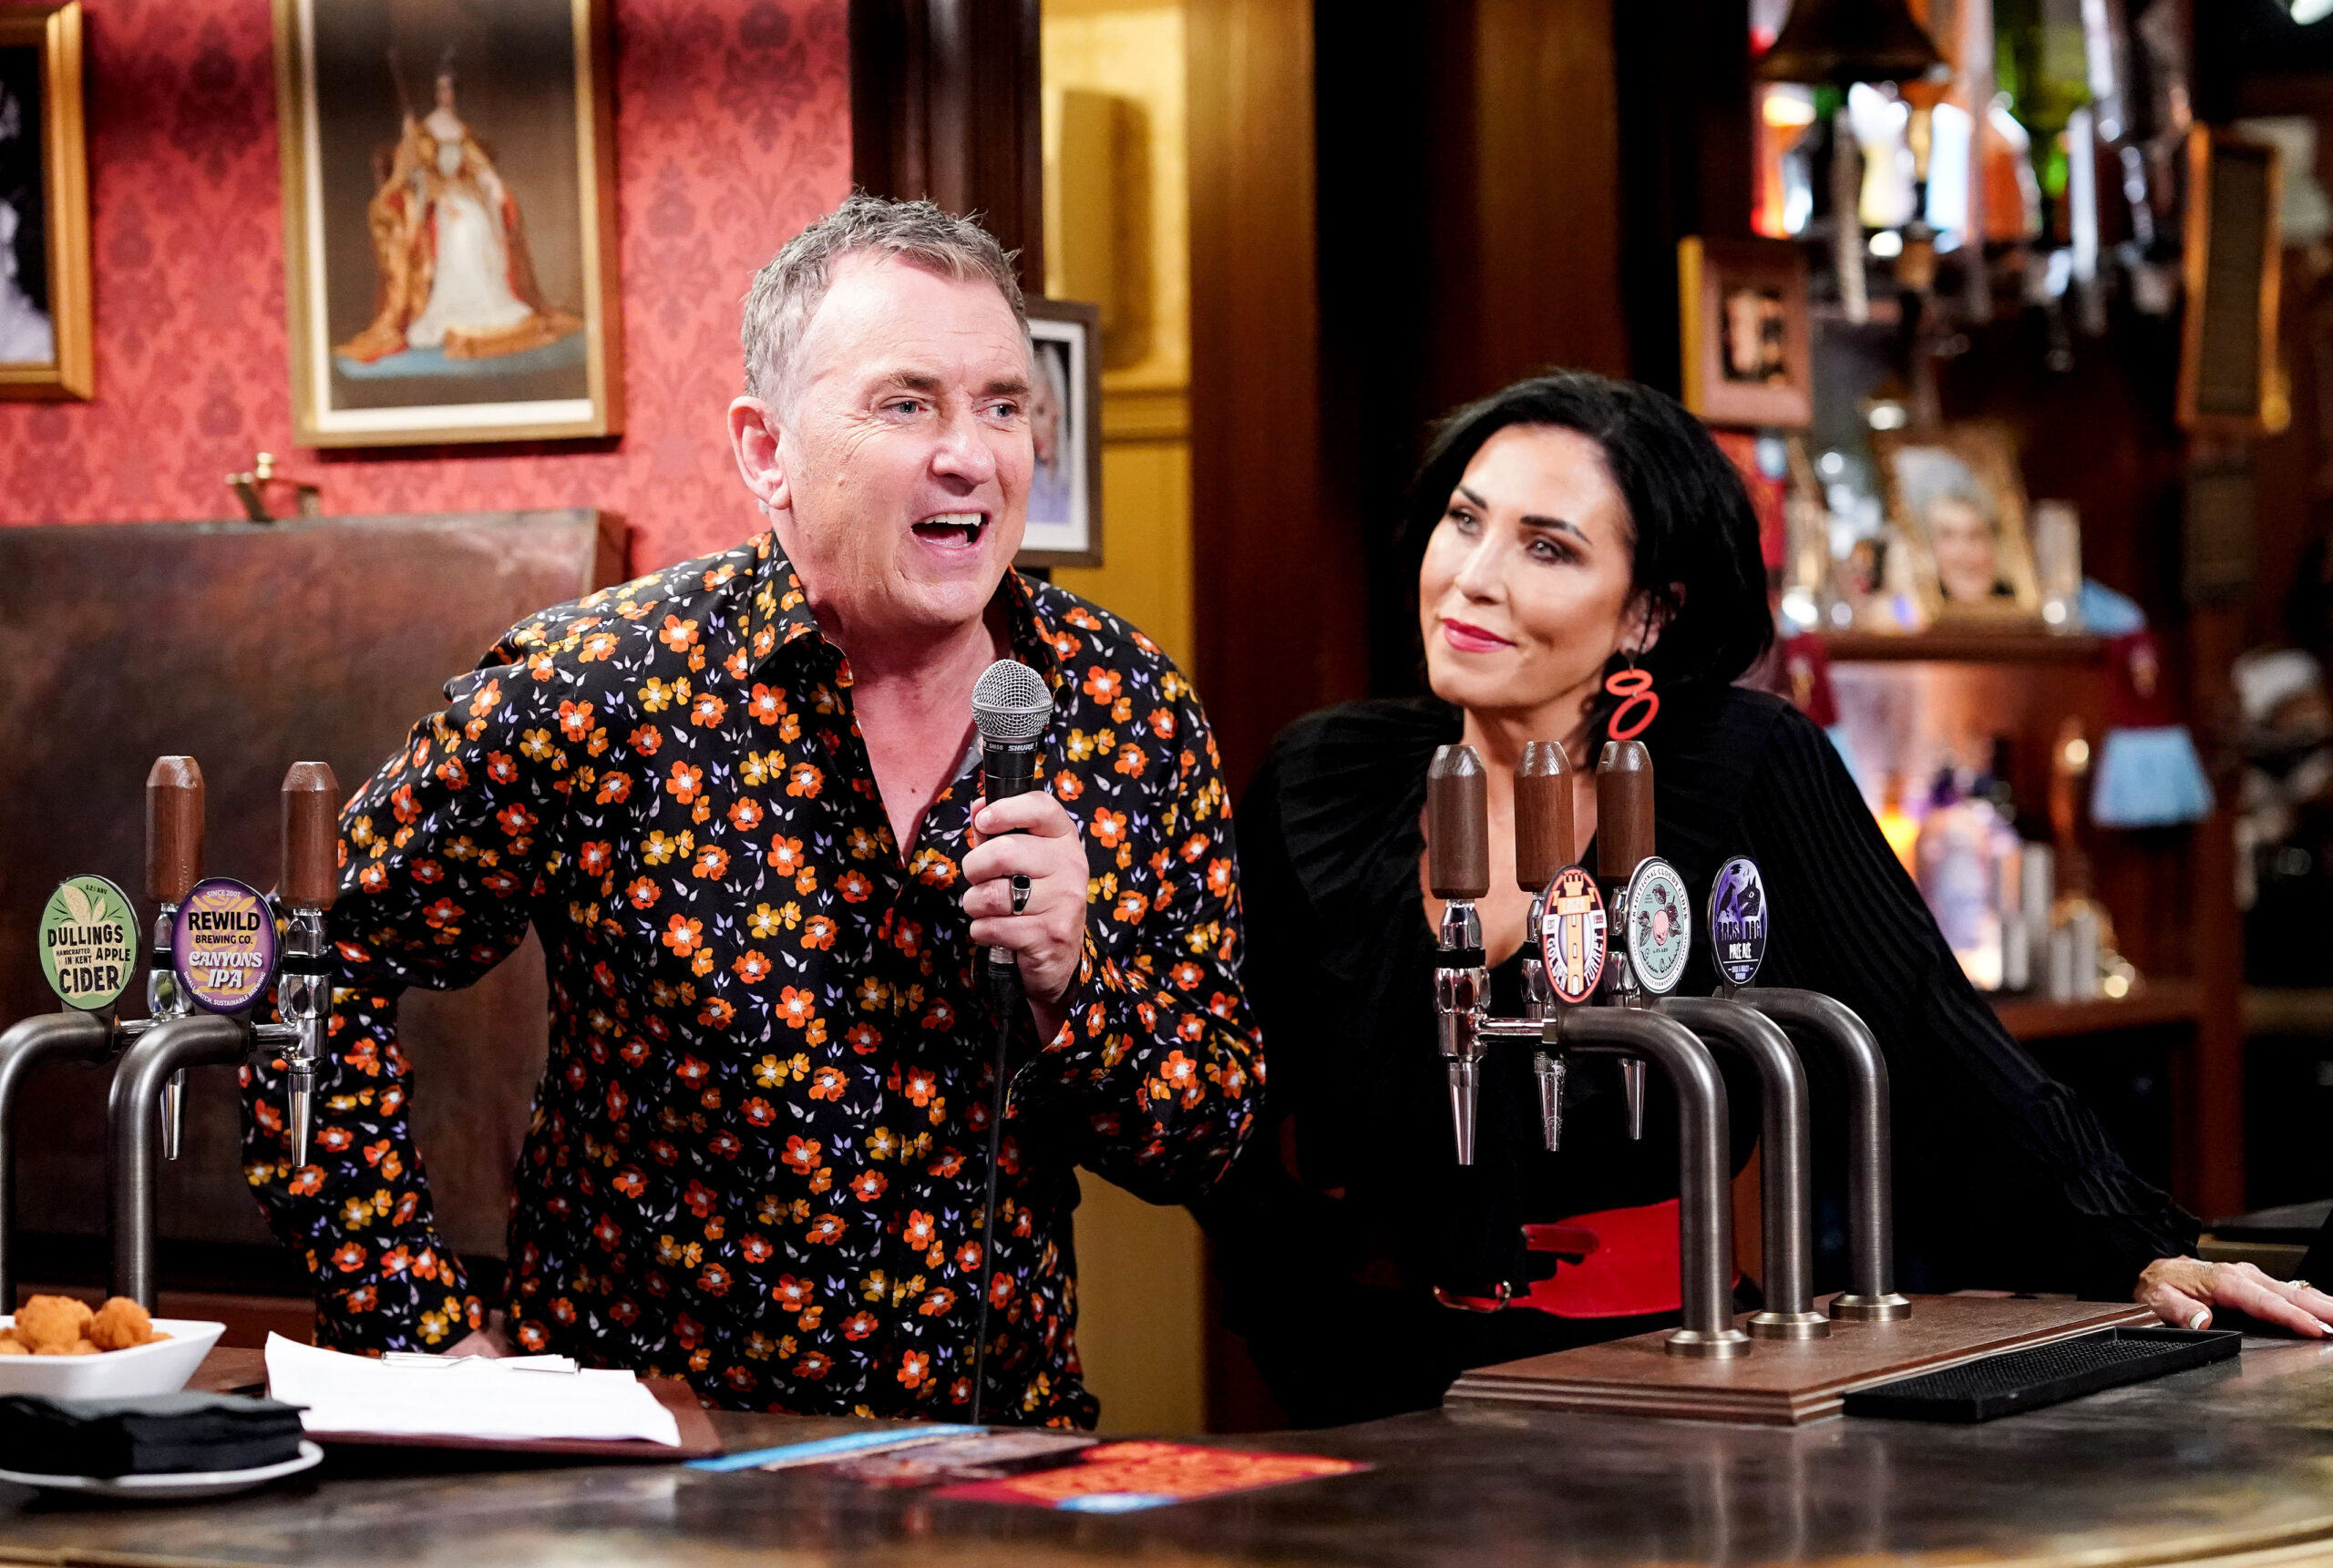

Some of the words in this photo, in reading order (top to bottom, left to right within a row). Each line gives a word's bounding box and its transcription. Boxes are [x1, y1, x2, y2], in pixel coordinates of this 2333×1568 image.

[1008, 743, 1034, 752] SHURE
[206, 889, 226, 897] SINCE
[226, 889, 241, 897] 2007
[1658, 867, 1680, 887] CLOUDY
[1679, 887, 1688, 919] CIDER
[188, 911, 261, 931] REWILD
[47, 924, 124, 948] DULLINGS
[195, 935, 237, 944] BREWING
[238, 935, 253, 945] CO.
[57, 948, 91, 957] HANDCRAFTED
[95, 948, 131, 962] APPLE
[188, 951, 262, 968] CANYONS
[1730, 942, 1742, 959] PALE
[1742, 942, 1752, 959] ALE
[65, 957, 73, 966] IN
[75, 955, 93, 965] KENT
[1547, 938, 1567, 991] GOLDEN
[1584, 933, 1604, 987] TURRET
[59, 966, 121, 994] CIDER
[208, 969, 243, 989] IPA
[183, 971, 196, 992] SMALL
[213, 994, 250, 1007] SUSTAINABLE
[248, 971, 266, 999] BREWING
